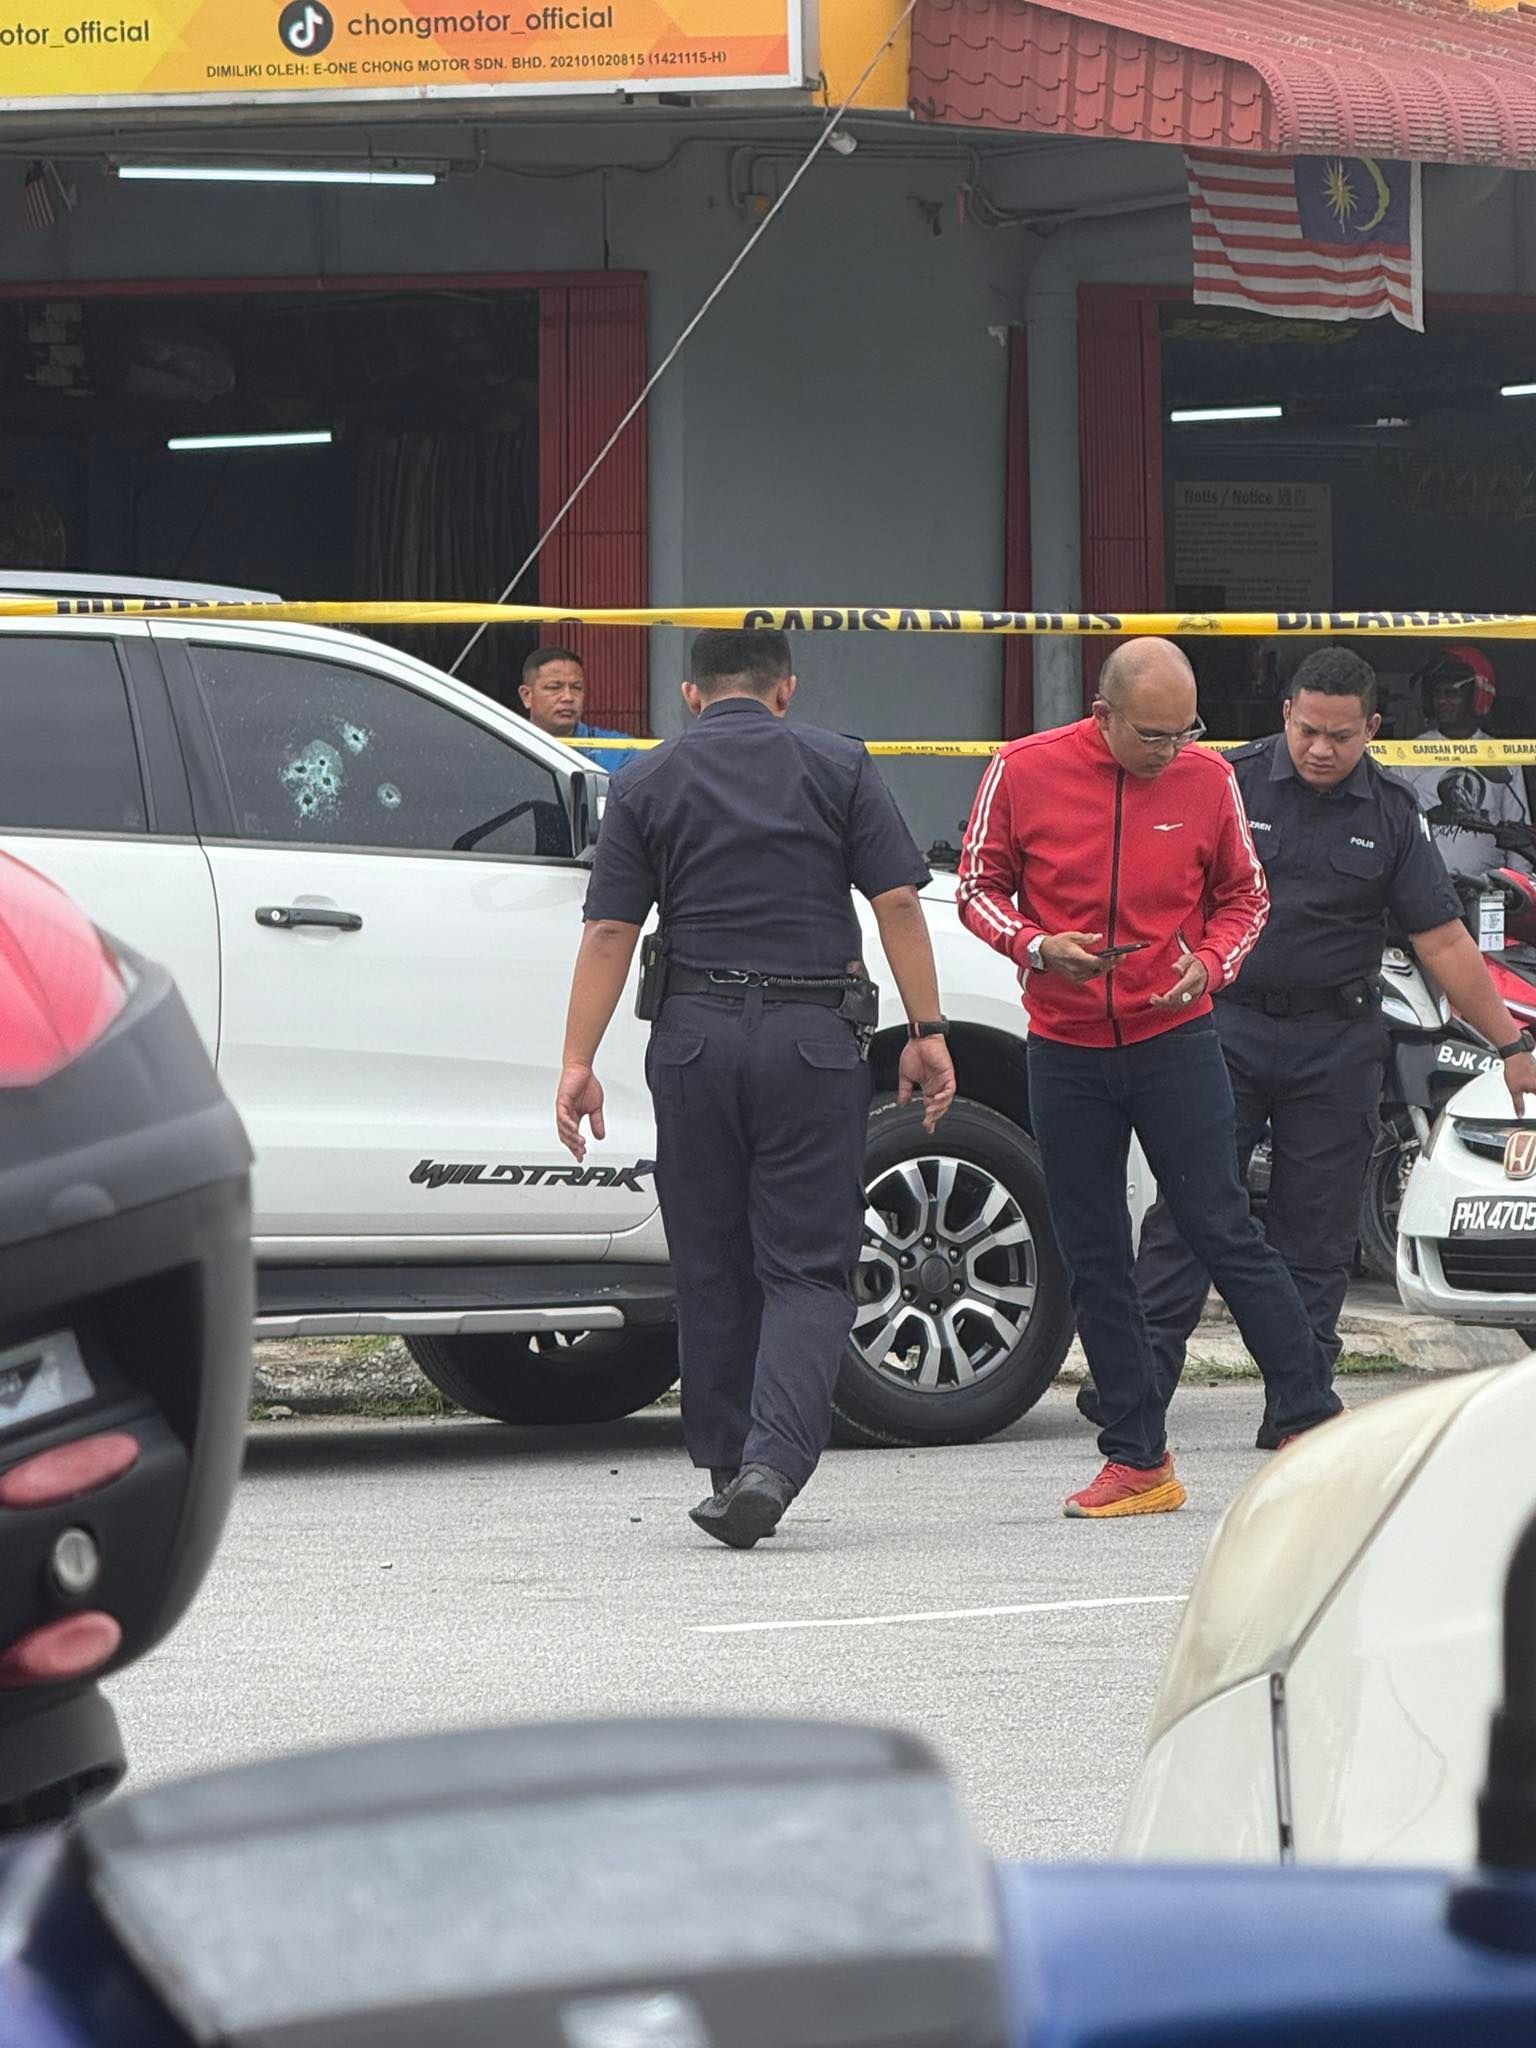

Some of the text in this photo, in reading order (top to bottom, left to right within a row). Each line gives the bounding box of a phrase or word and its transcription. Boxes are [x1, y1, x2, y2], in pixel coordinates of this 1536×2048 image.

[347, 6, 613, 39] chongmotor_official
[206, 51, 727, 78] DIMILIKI OLEH: E-ONE CHONG MOTOR SDN. BHD. 202101020815 (1421115-H)
[1453, 744, 1478, 755] POLIS
[1350, 836, 1375, 849] POLIS
[1438, 1045, 1477, 1071] BJK
[409, 1159, 657, 1193] WILDTRAK
